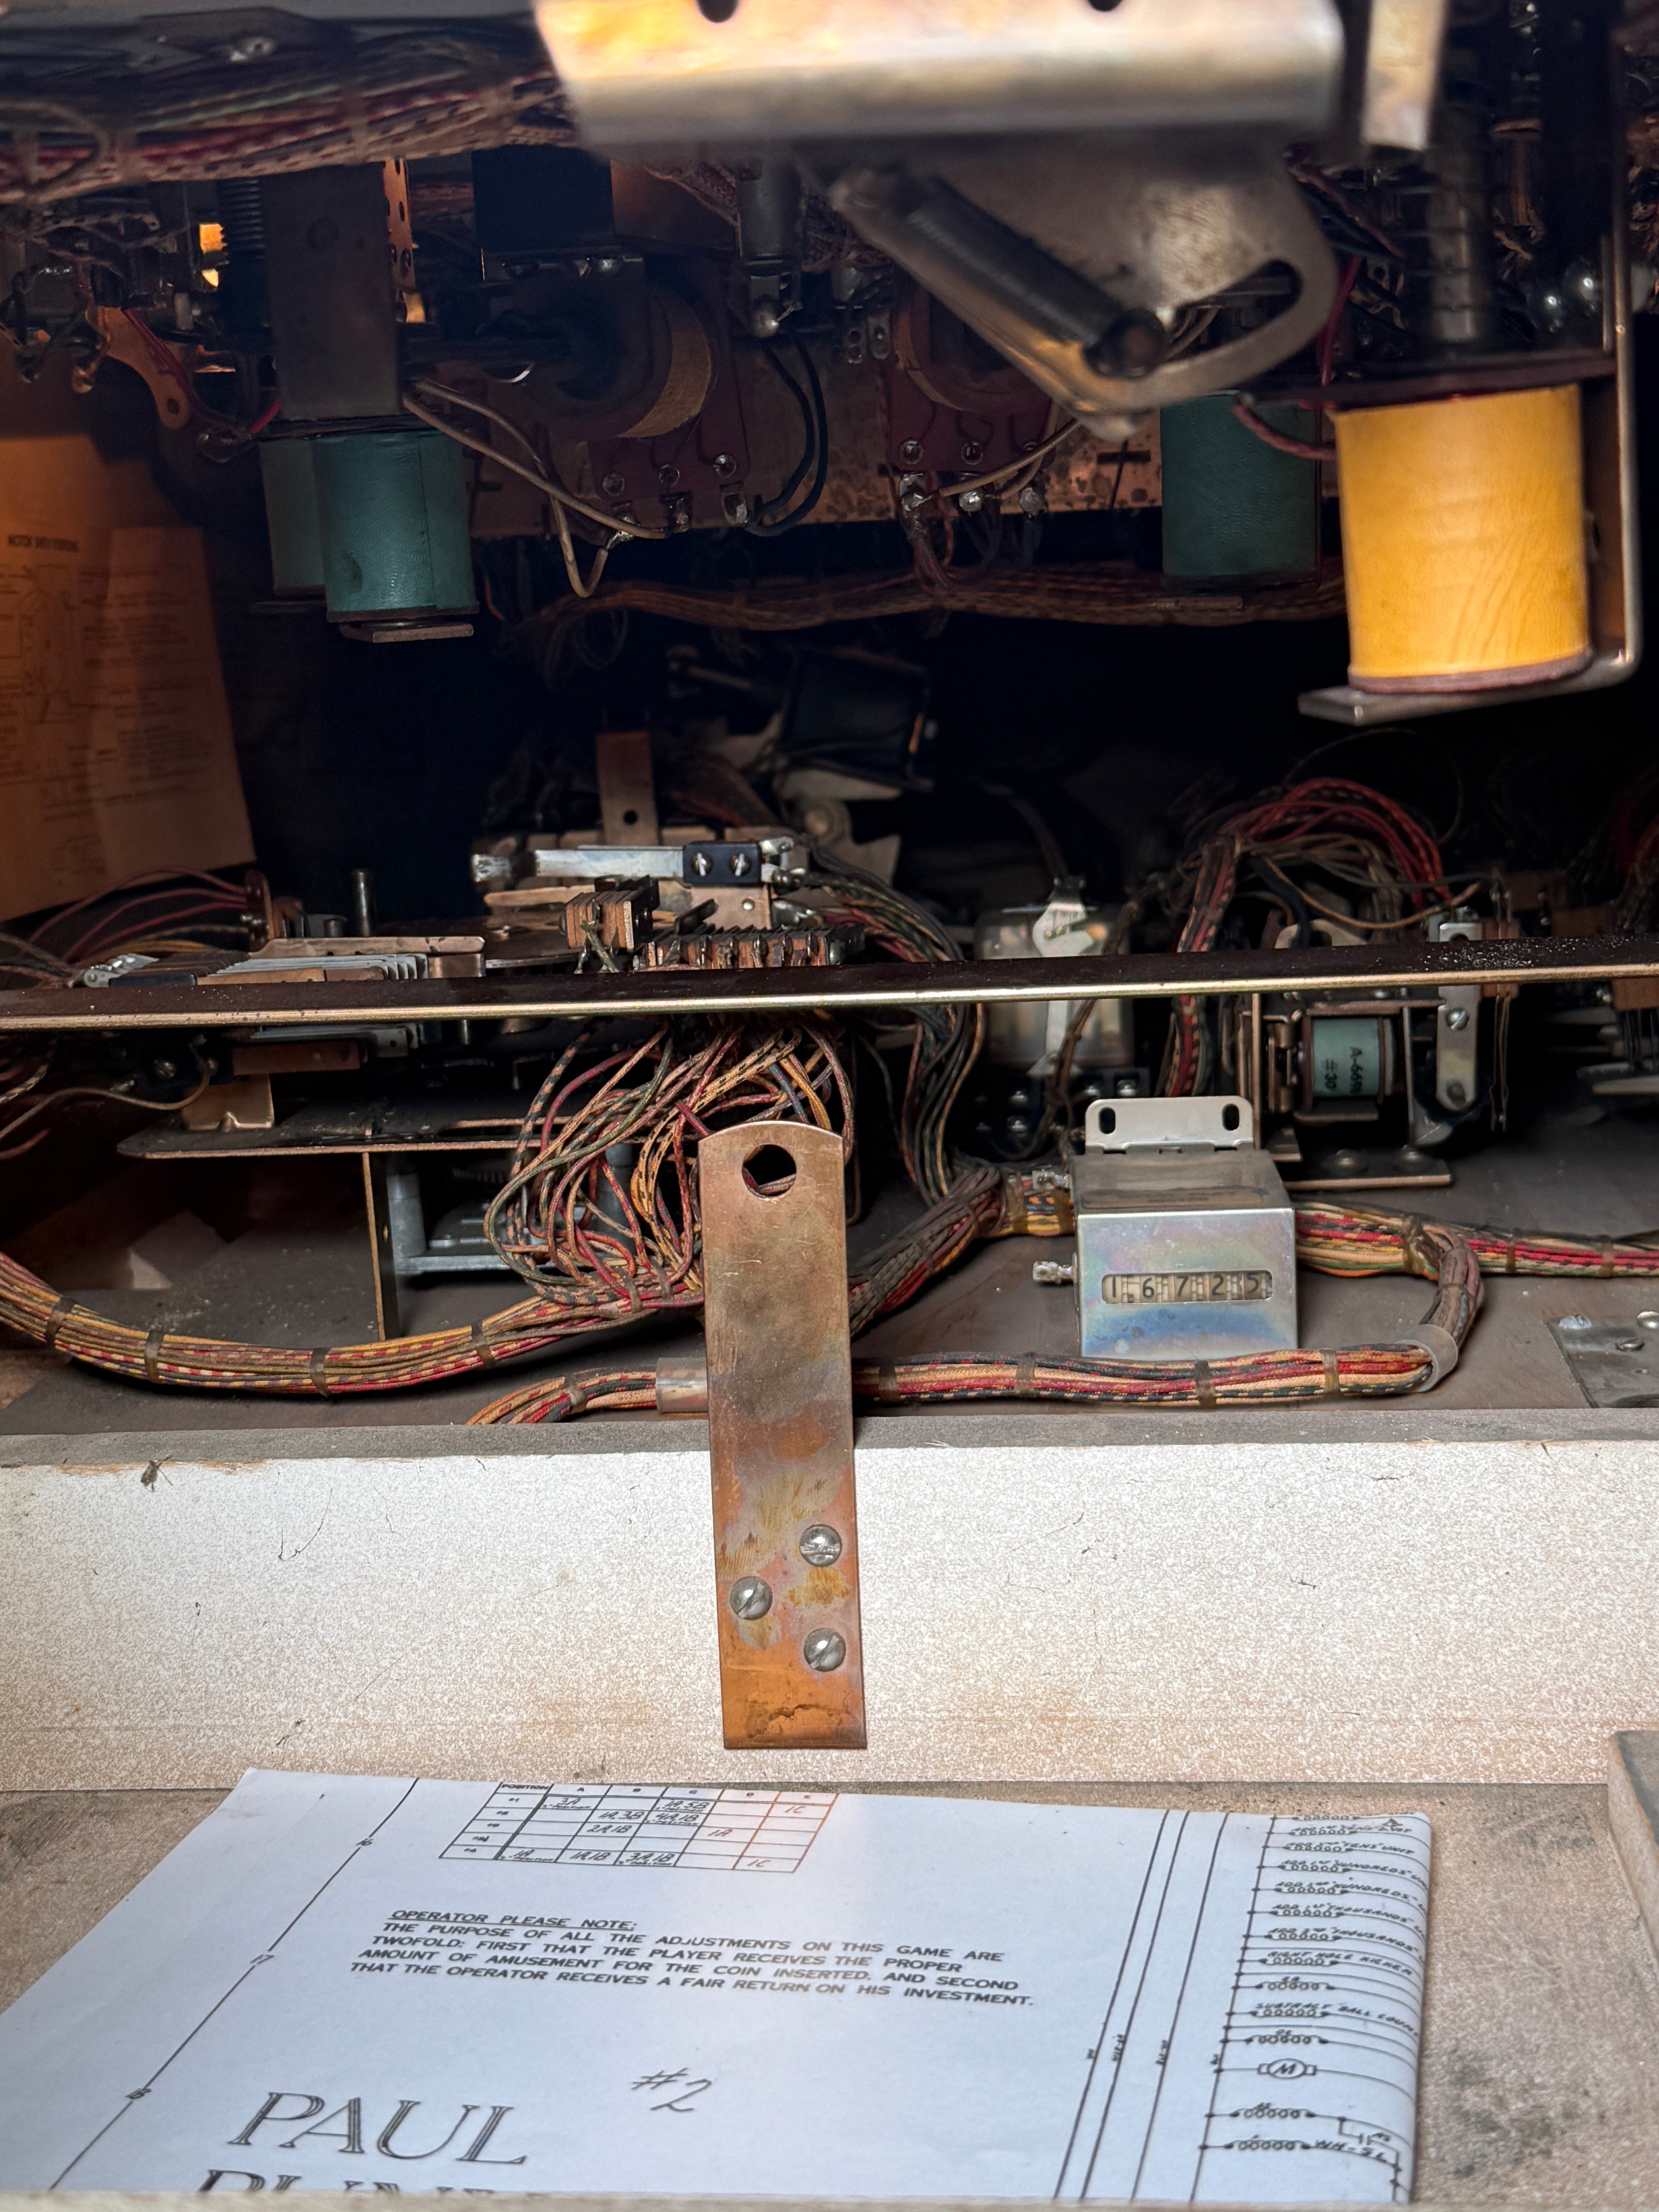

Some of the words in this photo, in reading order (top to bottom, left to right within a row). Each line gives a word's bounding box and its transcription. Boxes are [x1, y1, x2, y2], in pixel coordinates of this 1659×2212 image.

[785, 1805, 807, 1814] 1C
[708, 1829, 733, 1837] 1A
[747, 1859, 771, 1867] 1C
[391, 1910, 489, 1922] OPERATOR
[500, 1915, 571, 1926] PLEASE
[372, 1935, 466, 1948] TWOFOLD:
[476, 1940, 532, 1952] FIRST
[543, 1943, 592, 1954] THAT
[603, 1946, 641, 1957] THE
[648, 1948, 722, 1961] PLAYER
[733, 1953, 826, 1966] RECEIVES
[835, 1955, 873, 1966] THE
[883, 1958, 963, 1973] PROPER
[383, 1922, 419, 1932] THE
[428, 1924, 515, 1937] PURPOSE
[523, 1929, 553, 1939] OF
[560, 1931, 596, 1941] ALL
[610, 1932, 647, 1943] THE
[655, 1936, 791, 1949] ADJUSTMENTS
[802, 1942, 831, 1951] ON
[841, 1942, 885, 1953] THIS
[896, 1945, 953, 1958] GAME
[964, 1950, 1005, 1962] ARE
[350, 1962, 399, 1973] THAT
[404, 1963, 442, 1974] THE
[446, 1966, 549, 1980] OPERATOR
[556, 1971, 649, 1985] RECEIVES
[656, 1977, 671, 1986] A
[680, 1977, 726, 1989] FAIR
[732, 1979, 810, 1993] RETURN
[815, 1983, 846, 1994] ON
[856, 1984, 891, 1995] HIS
[903, 1987, 1035, 2006] INVESTMENT.
[358, 1949, 441, 1960] AMOUNT
[448, 1952, 477, 1962] OF
[485, 1955, 604, 1969] AMUSEMENT
[612, 1960, 654, 1971] FOR
[666, 1962, 703, 1973] THE
[713, 1965, 762, 1977] COIN
[883, 1972, 926, 1984] AND
[935, 1976, 1019, 1990] SECOND
[1275, 2063, 1297, 2075] M
[630, 2067, 713, 2112] #2
[227, 2092, 528, 2165] PAUL
